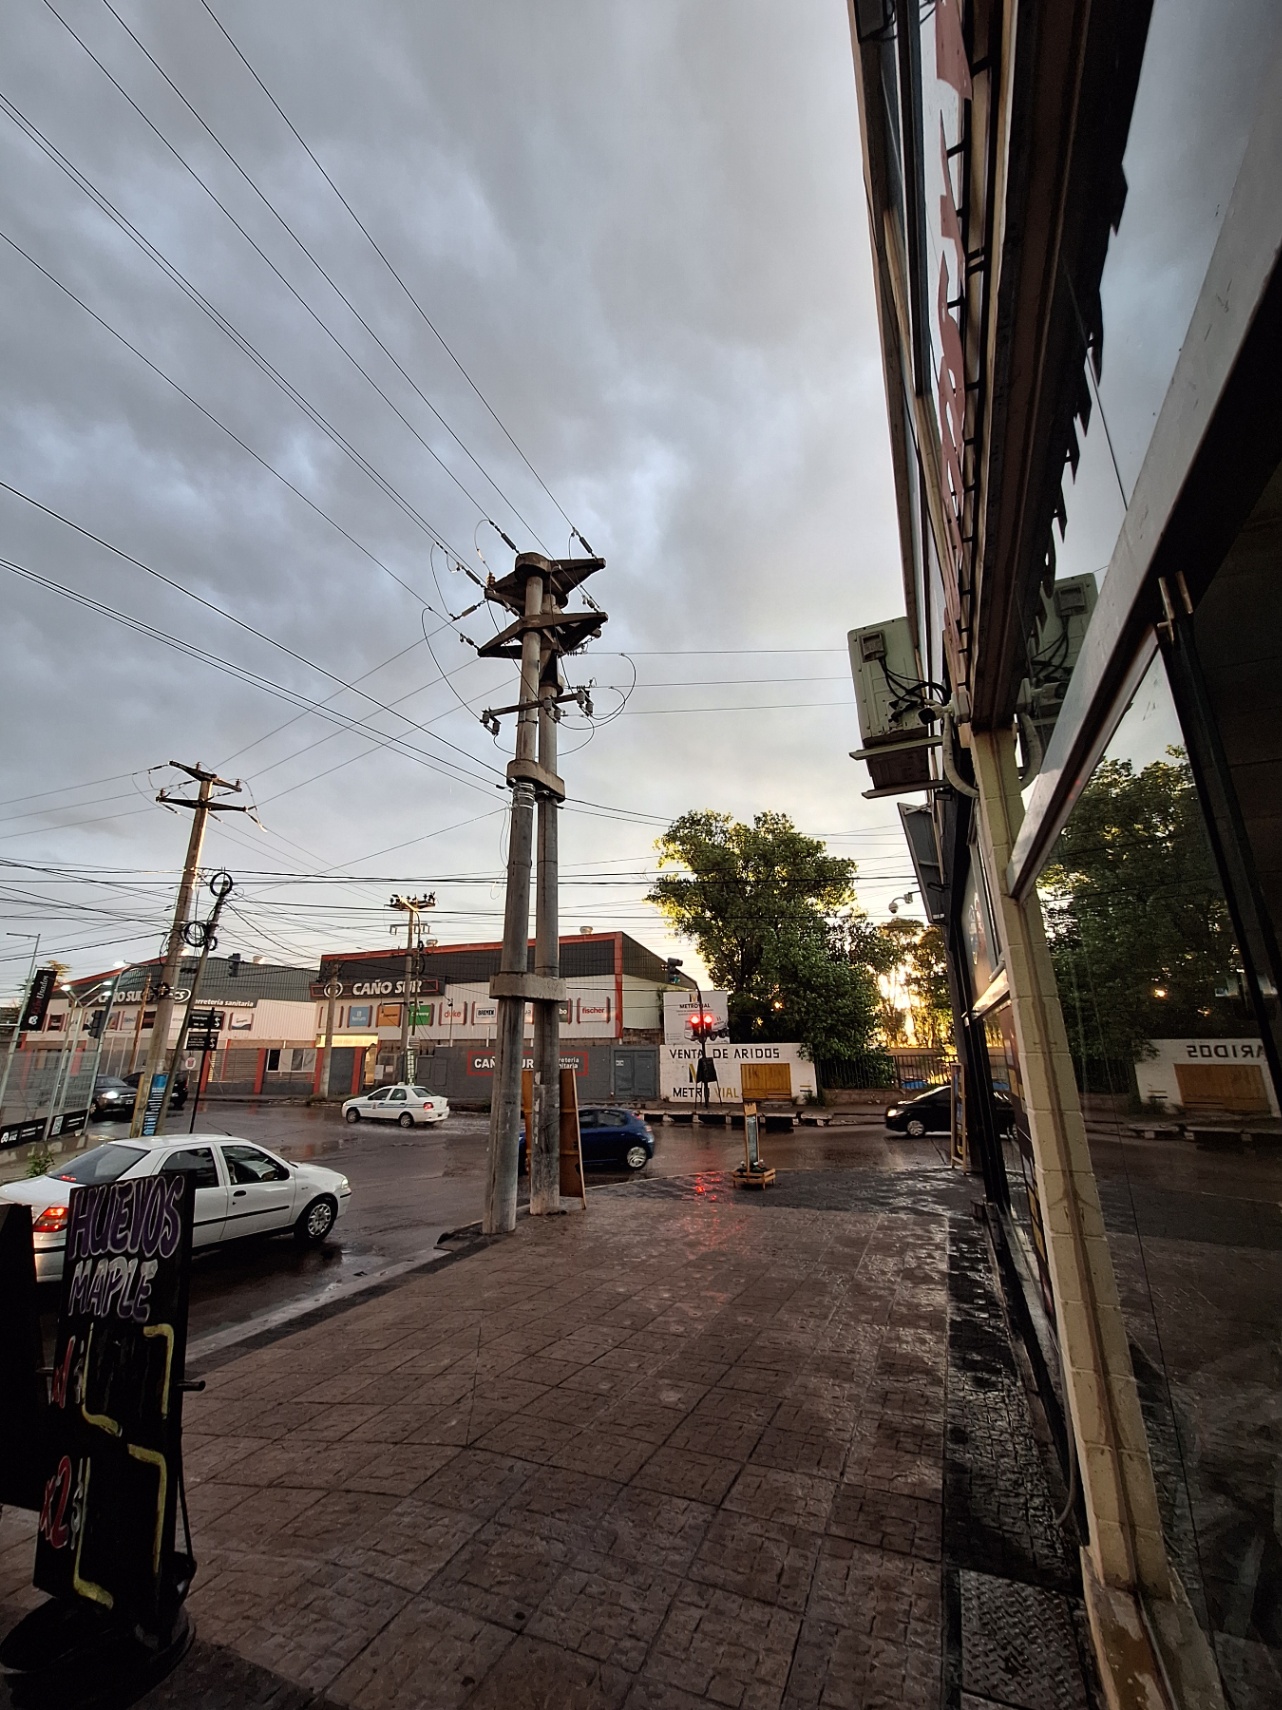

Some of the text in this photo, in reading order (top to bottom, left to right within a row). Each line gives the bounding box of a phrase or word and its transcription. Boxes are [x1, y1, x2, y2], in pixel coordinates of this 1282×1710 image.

[352, 978, 392, 996] CAÑO
[224, 999, 254, 1008] sanitaria
[582, 1006, 605, 1014] fischer
[669, 1048, 780, 1059] VENTA DE ARIDOS
[68, 1175, 185, 1260] HUEVOS
[68, 1256, 159, 1323] MAPLE
